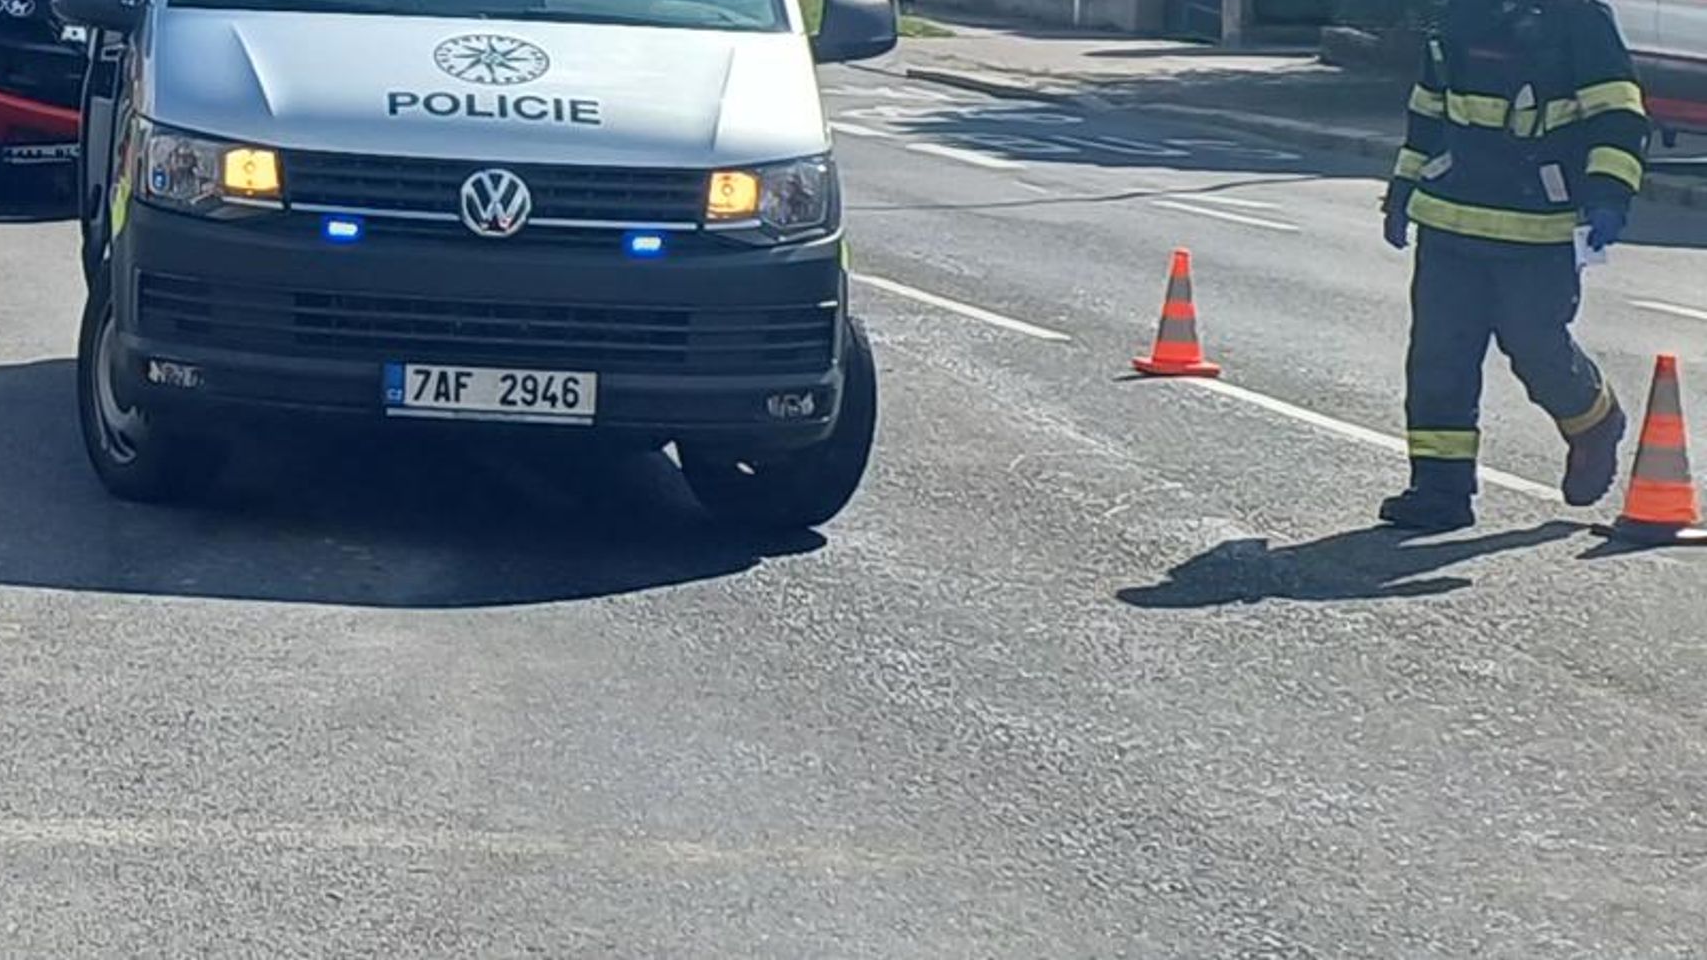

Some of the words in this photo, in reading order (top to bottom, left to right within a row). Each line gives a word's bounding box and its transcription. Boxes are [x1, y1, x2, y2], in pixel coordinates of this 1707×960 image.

[388, 92, 602, 126] POLICIE
[412, 369, 473, 403] 7AF
[499, 374, 581, 409] 2946
